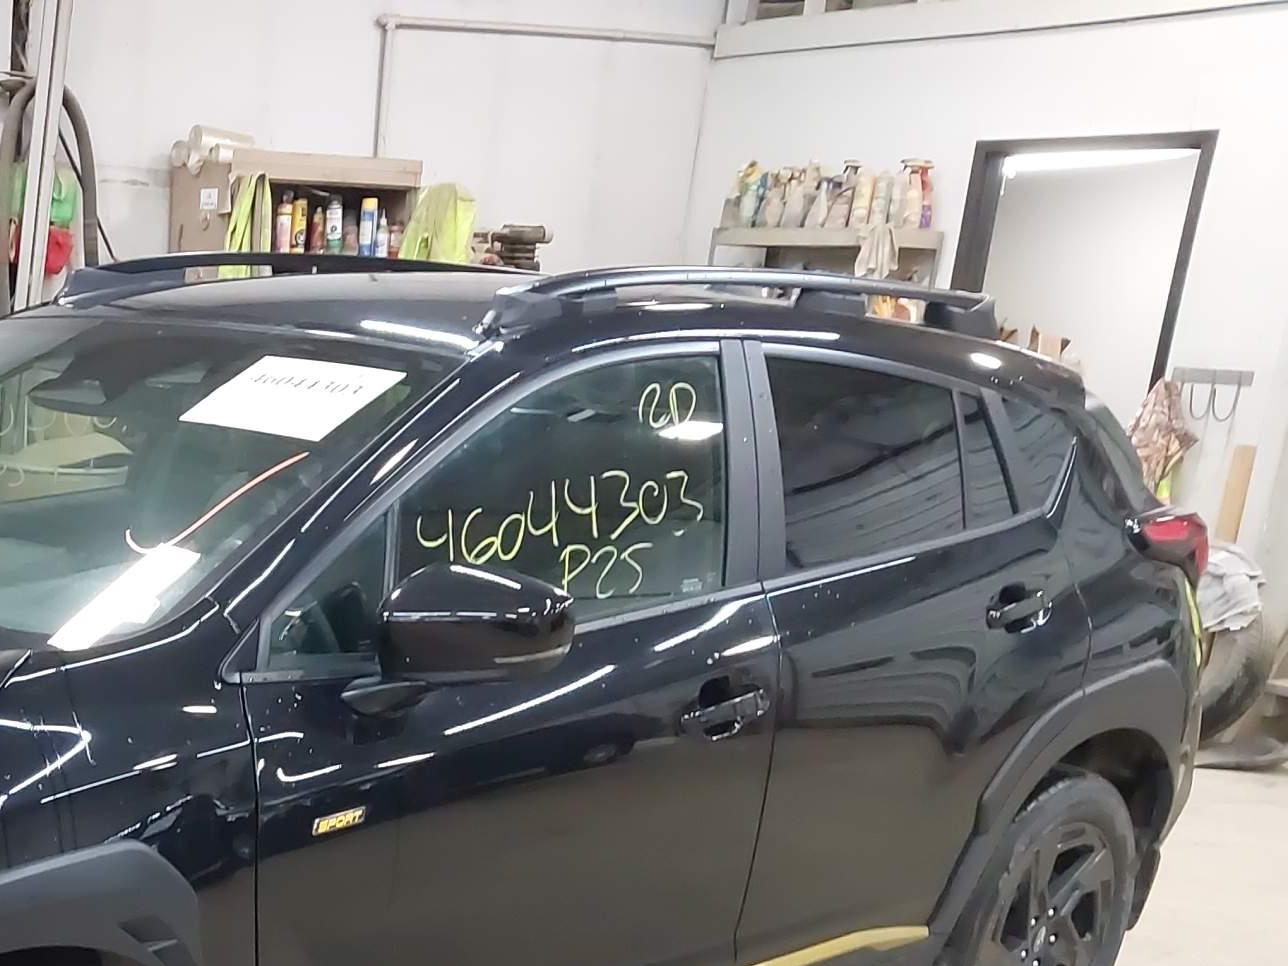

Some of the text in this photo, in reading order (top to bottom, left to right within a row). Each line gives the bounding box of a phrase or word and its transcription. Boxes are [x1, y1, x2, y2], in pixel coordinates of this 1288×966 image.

[416, 470, 703, 566] 46044303
[559, 543, 654, 599] P25
[317, 810, 363, 833] SPORT
